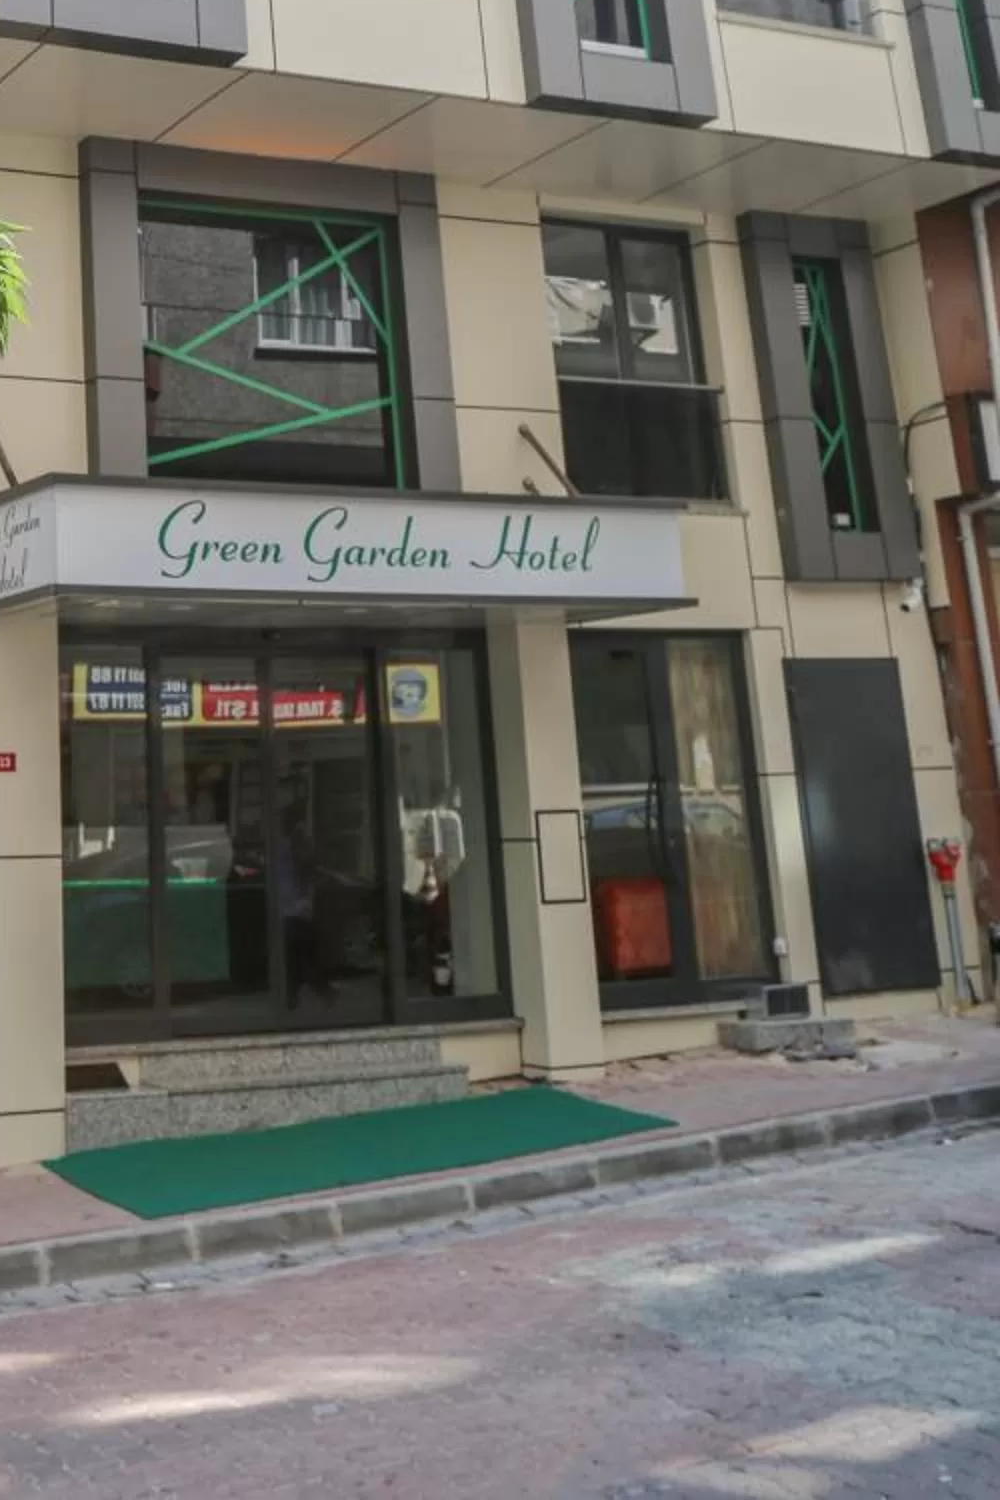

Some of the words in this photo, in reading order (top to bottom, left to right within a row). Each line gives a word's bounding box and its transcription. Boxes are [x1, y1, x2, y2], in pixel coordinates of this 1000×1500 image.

[3, 503, 40, 549] Garden
[157, 500, 285, 579] Green
[303, 507, 451, 583] Garden
[468, 514, 602, 574] Hotel
